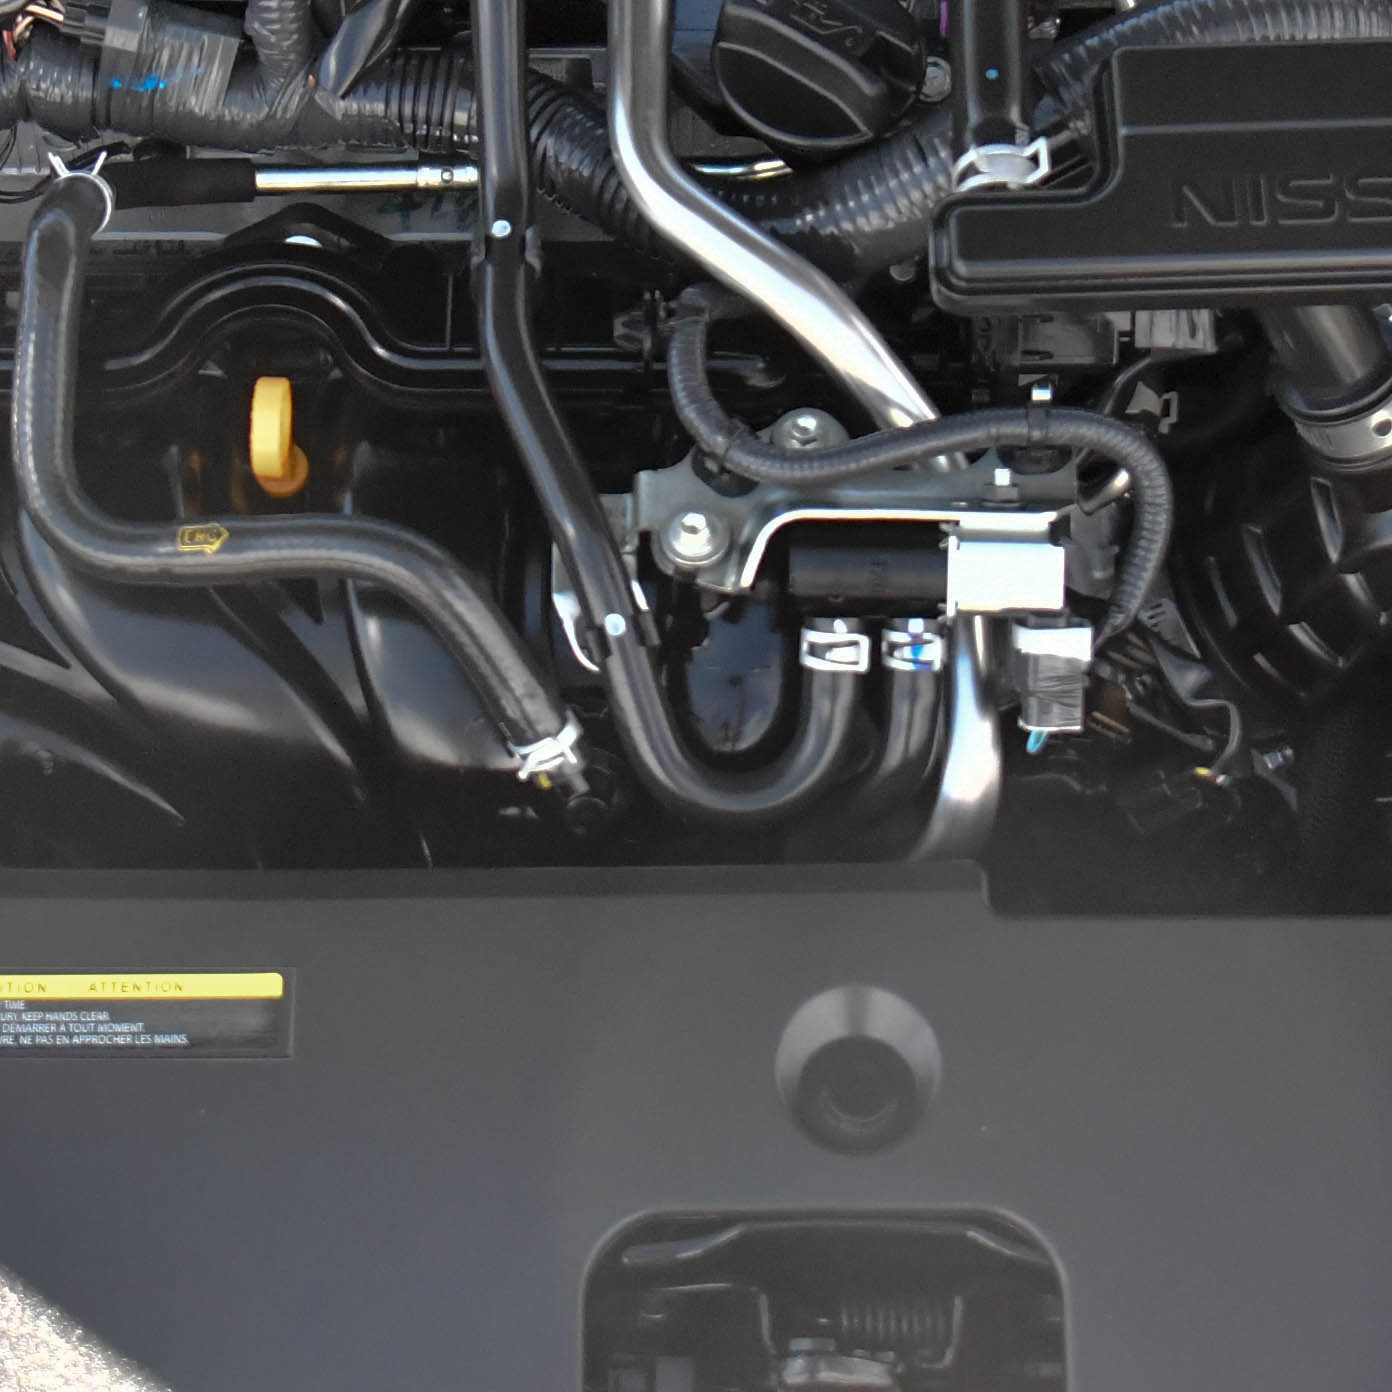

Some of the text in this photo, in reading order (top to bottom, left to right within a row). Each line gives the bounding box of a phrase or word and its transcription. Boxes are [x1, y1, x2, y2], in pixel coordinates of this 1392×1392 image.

[88, 981, 184, 992] ATTENTION
[22, 1012, 43, 1020] KEEP
[46, 1012, 78, 1020] HANDS
[69, 1023, 95, 1032] TOUT
[19, 1036, 32, 1044] NE
[35, 1036, 53, 1044] PAS
[56, 1036, 70, 1044] EN
[72, 1035, 131, 1044] APPROCHER
[135, 1035, 152, 1044] LES
